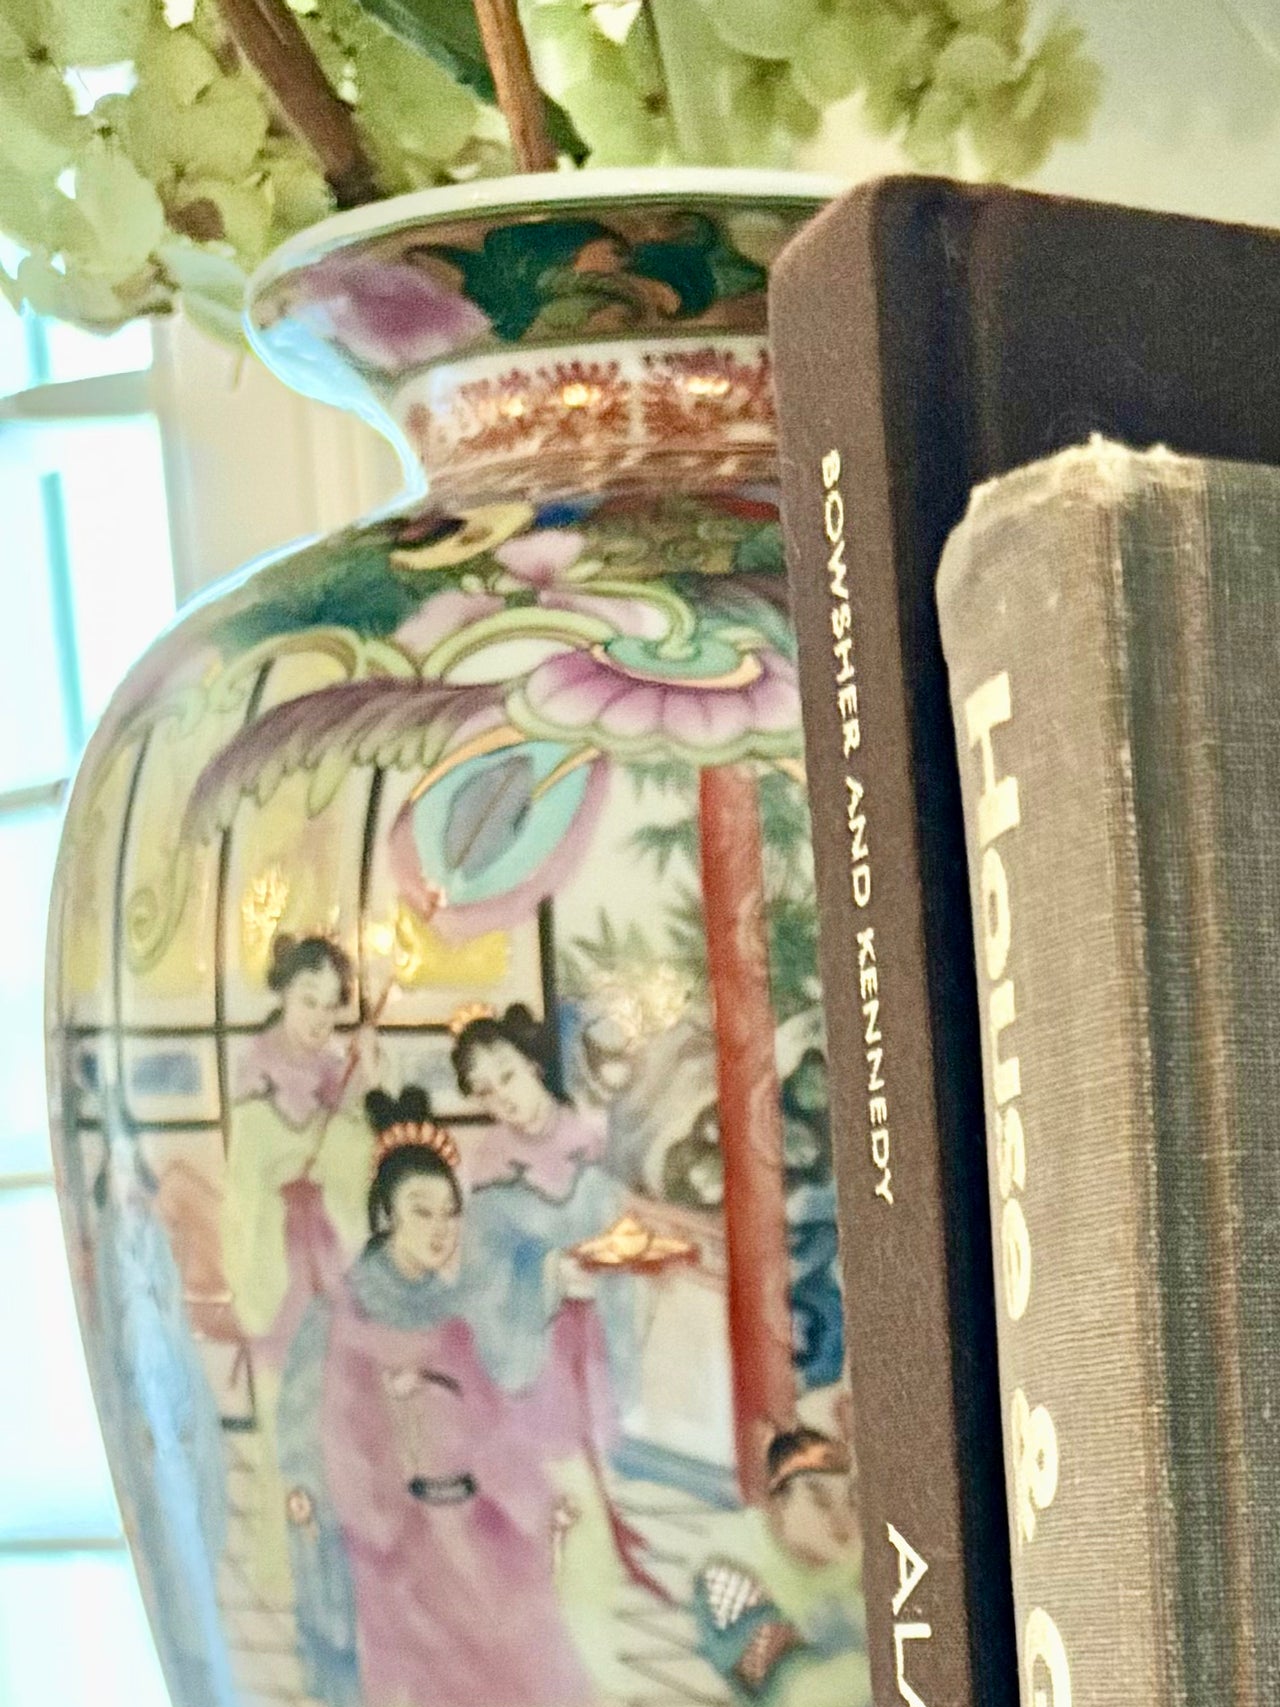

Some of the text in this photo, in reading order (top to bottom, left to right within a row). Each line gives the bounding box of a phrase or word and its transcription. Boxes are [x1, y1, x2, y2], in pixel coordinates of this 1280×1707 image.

[821, 449, 894, 1205] BOWSHER AND KENNEDY
[963, 671, 1031, 1320] House
[1010, 1386, 1059, 1546] &
